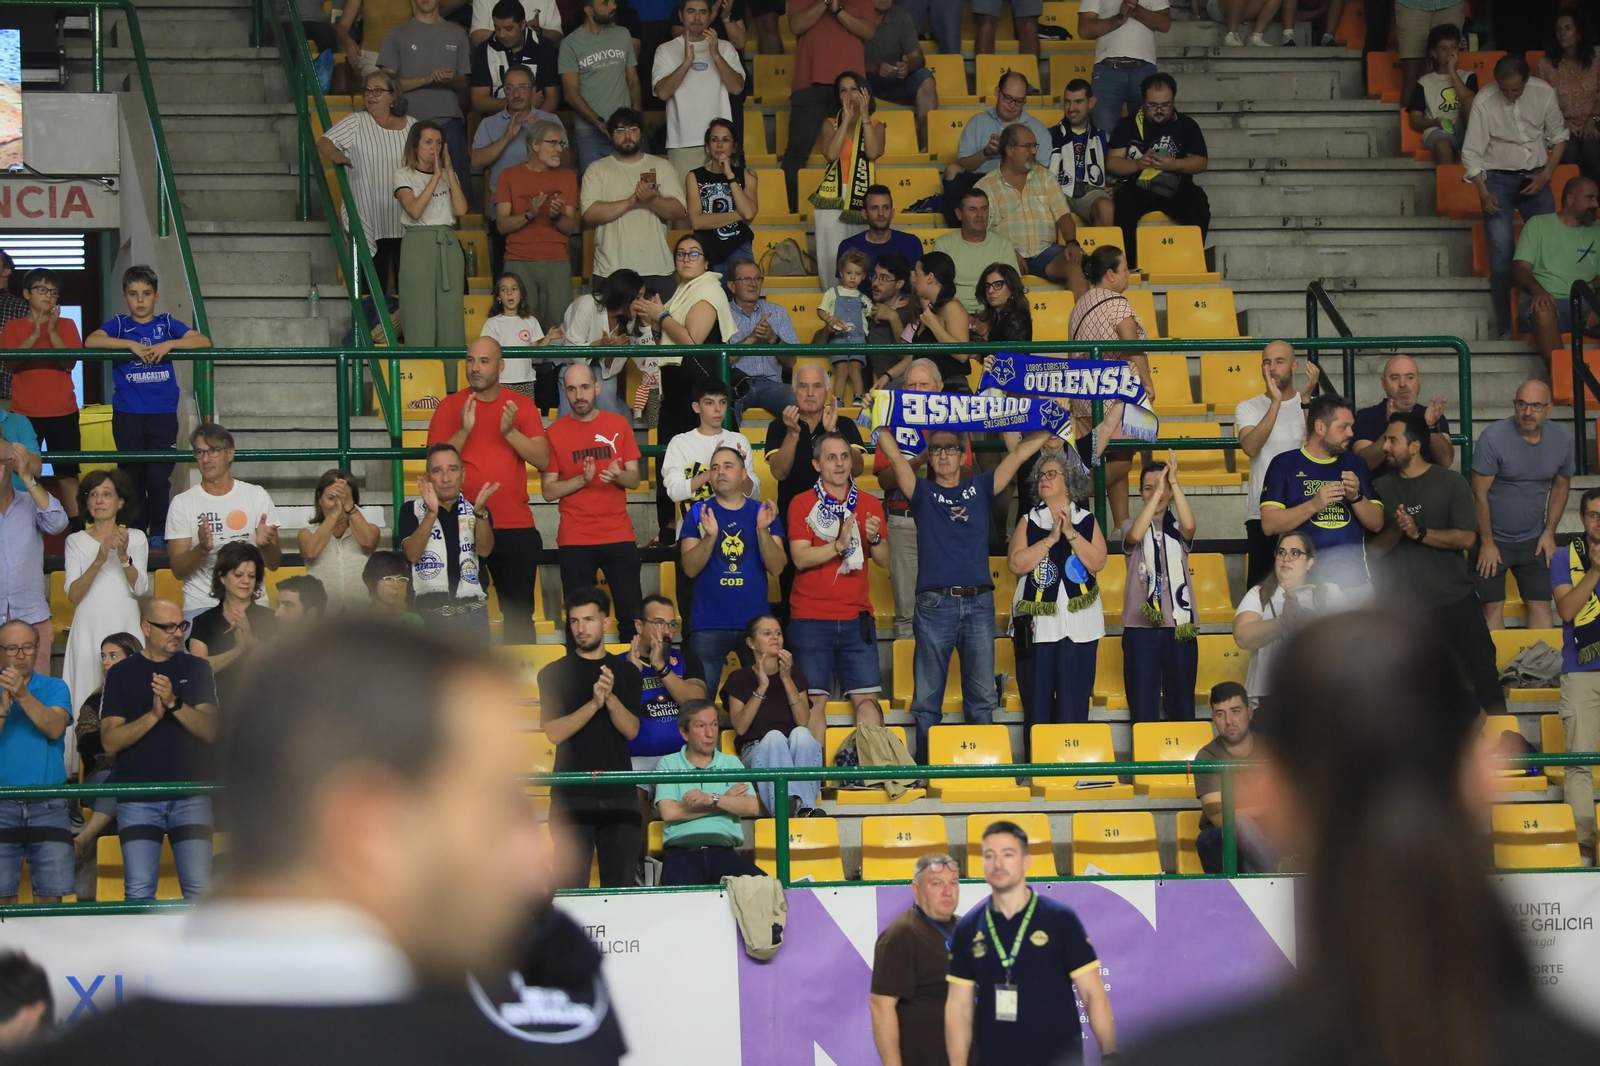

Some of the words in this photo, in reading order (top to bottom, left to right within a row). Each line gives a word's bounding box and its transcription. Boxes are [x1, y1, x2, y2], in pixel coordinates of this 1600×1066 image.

[1161, 237, 1174, 245] 46
[792, 304, 805, 312] 40
[1026, 363, 1042, 371] LOBOS
[1043, 362, 1069, 371] COBISTAS
[132, 371, 170, 381] VILACASTRO
[1024, 366, 1140, 398] OURENSE
[901, 393, 1032, 425] OURENSE
[572, 446, 612, 464] PUMA
[1317, 513, 1344, 521] Galicia
[720, 578, 744, 586] COB
[960, 741, 976, 750] 49
[1064, 739, 1079, 747] 50
[1523, 820, 1538, 829] 54
[789, 834, 803, 843] 47
[896, 832, 911, 841] 48
[1509, 902, 1561, 916] XUNTA
[1532, 917, 1593, 931] GALICIA
[1529, 964, 1564, 974] ORTE
